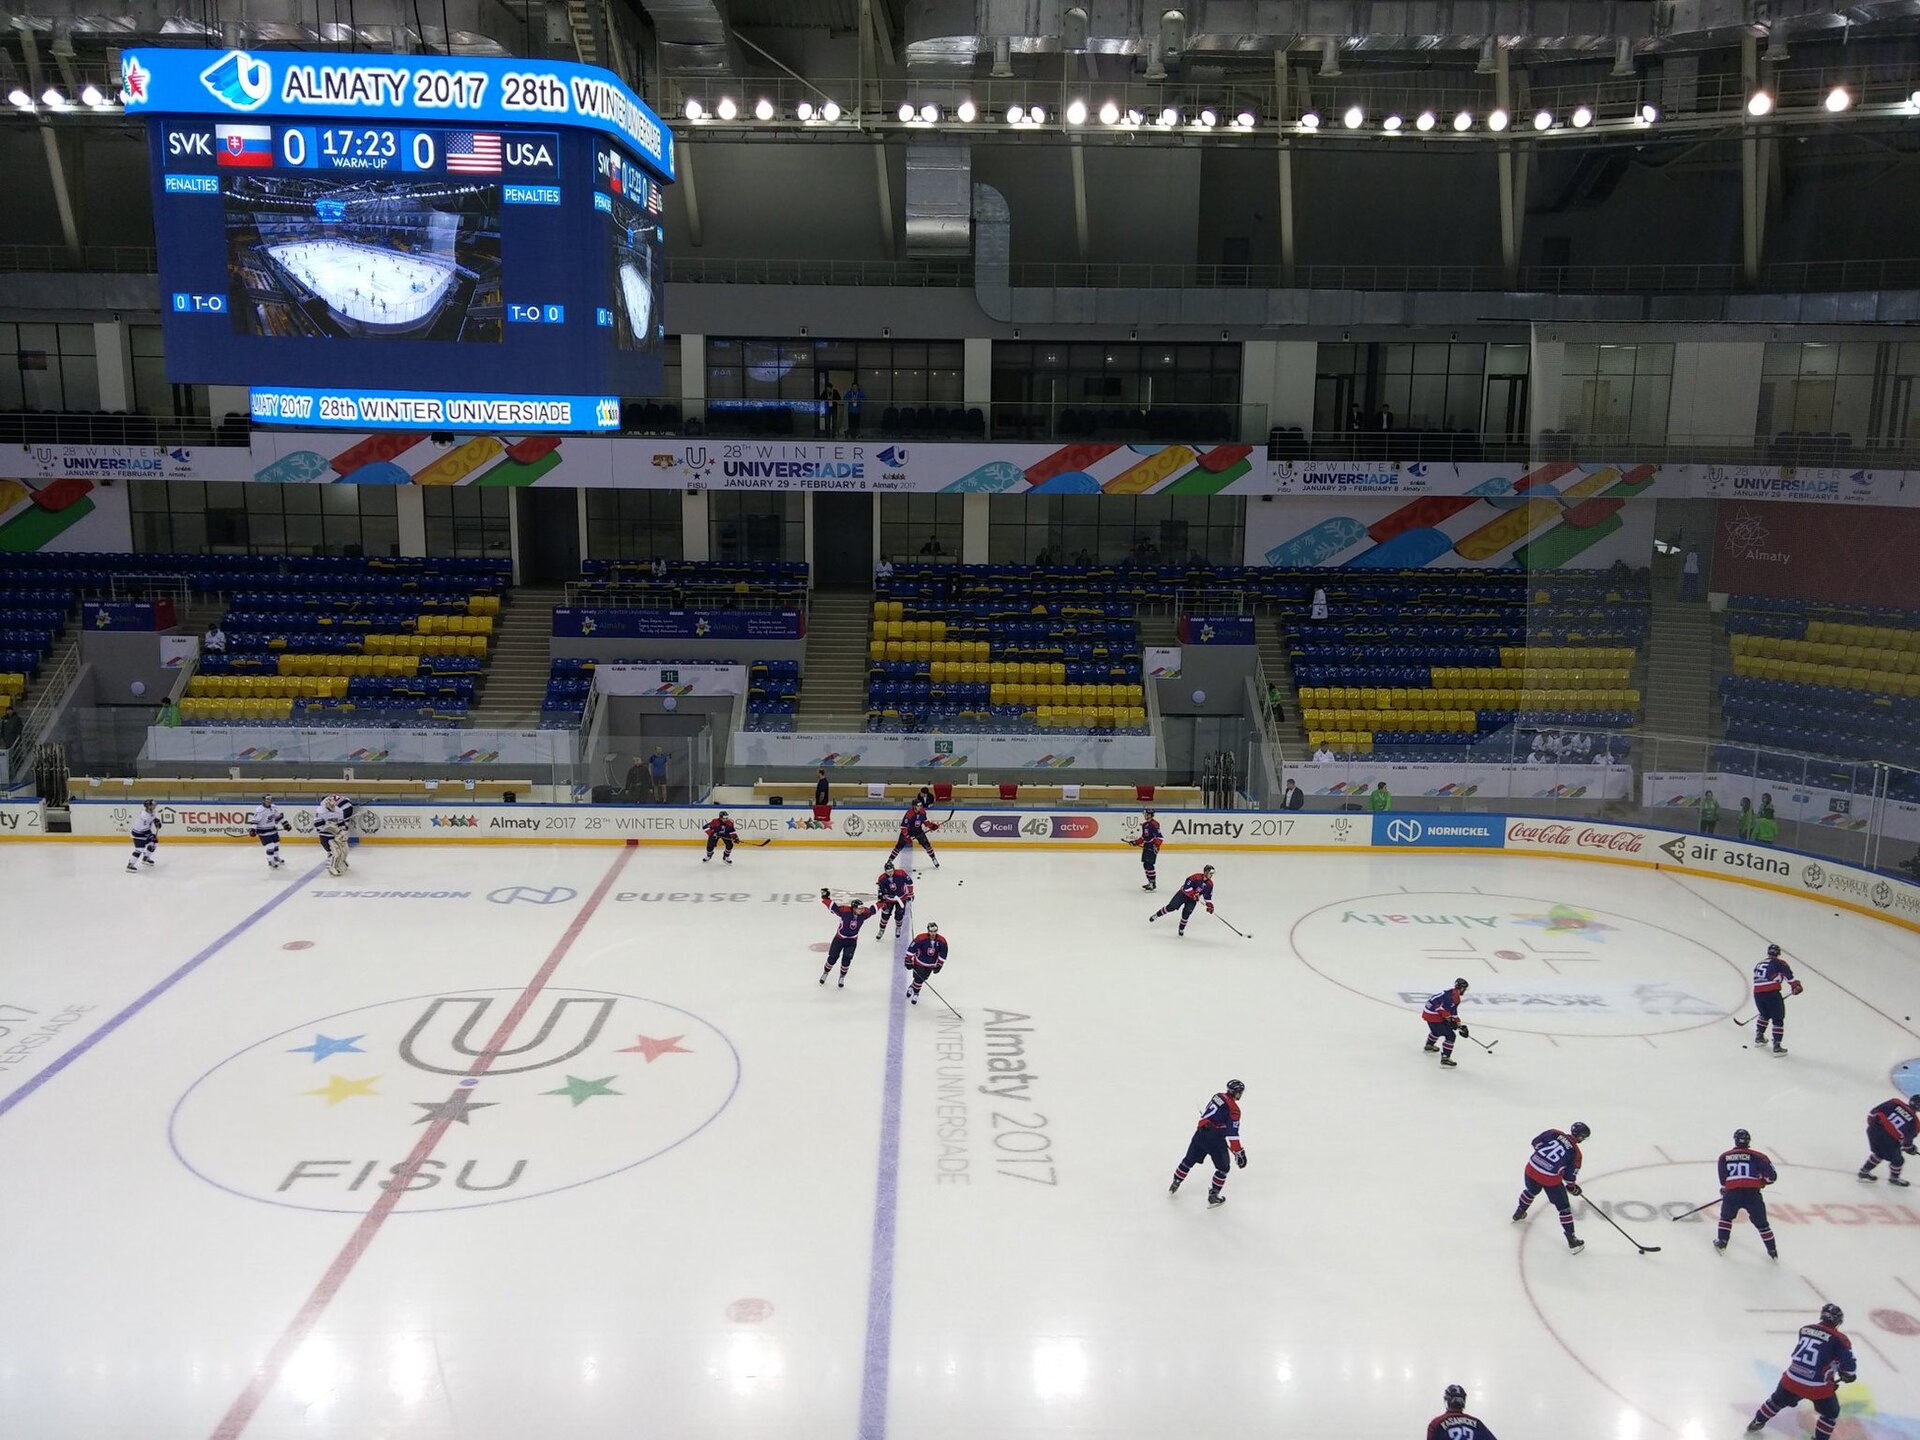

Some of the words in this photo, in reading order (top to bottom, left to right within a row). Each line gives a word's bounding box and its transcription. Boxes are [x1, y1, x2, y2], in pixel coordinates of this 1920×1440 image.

[285, 70, 406, 101] ALMATY
[417, 74, 485, 103] 2017
[505, 77, 565, 107] 28th
[575, 82, 626, 124] WINTER
[168, 131, 214, 156] SVK
[283, 128, 306, 166] 0
[322, 130, 397, 157] 17:23
[412, 132, 435, 169] 0
[331, 156, 389, 169] WARM-UP
[506, 142, 553, 167] USA
[165, 177, 218, 192] PENALTIES
[505, 188, 560, 203] PENALTIES
[176, 294, 186, 311] 0
[192, 295, 222, 312] T-O
[512, 306, 541, 321] T-O
[548, 305, 559, 322] 0
[281, 397, 311, 416] 2017
[321, 399, 355, 418] 28th
[361, 402, 441, 420] WINTER
[449, 404, 570, 422] UNIVERSIADE
[756, 446, 864, 460] WINTER
[64, 458, 163, 470] UNIVERSIADE
[723, 461, 865, 479] UNIVERSIADE
[118, 470, 157, 478] FEBRUARY
[1303, 473, 1399, 485] UNIVERSIADE
[687, 482, 707, 490] FISU
[723, 479, 773, 488] JANUARY
[777, 480, 789, 488] 29
[800, 480, 857, 489] FEBRUARY
[860, 481, 866, 489] 8
[872, 482, 898, 490] Almaty
[1733, 478, 1839, 493] UNIVERSIADE
[1745, 550, 1791, 565] Almaty
[179, 812, 255, 825] TECHNOD
[383, 815, 421, 826] SAMRUK
[489, 816, 541, 831] Almaty
[545, 817, 577, 830] 2017
[616, 817, 674, 830] WINTER
[679, 818, 779, 831] UNISIADE
[867, 819, 901, 829] SAMRU
[1022, 818, 1048, 836] 4G
[186, 826, 206, 834] Doing
[209, 827, 244, 835] everything
[993, 823, 1013, 832] Kcell
[1171, 818, 1244, 838] Almaty
[1250, 819, 1296, 836] 2017
[1427, 826, 1490, 837] NORNICKEL
[1507, 822, 1575, 846] Coca-Cola
[1576, 827, 1646, 853] Coca-Cola
[1691, 843, 1717, 861] air
[1724, 850, 1790, 876] astana
[1828, 873, 1869, 892] SAMRUK
[310, 889, 473, 899] NORNICKEL
[1341, 911, 1499, 928] Almaty
[978, 1008, 1039, 1102] Almaty
[937, 1066, 970, 1185] UNIVERSIADE
[992, 1112, 1057, 1186] 2017
[1538, 1139, 1566, 1163] 26
[276, 1159, 528, 1192] FISU
[1792, 1335, 1824, 1366] 25
